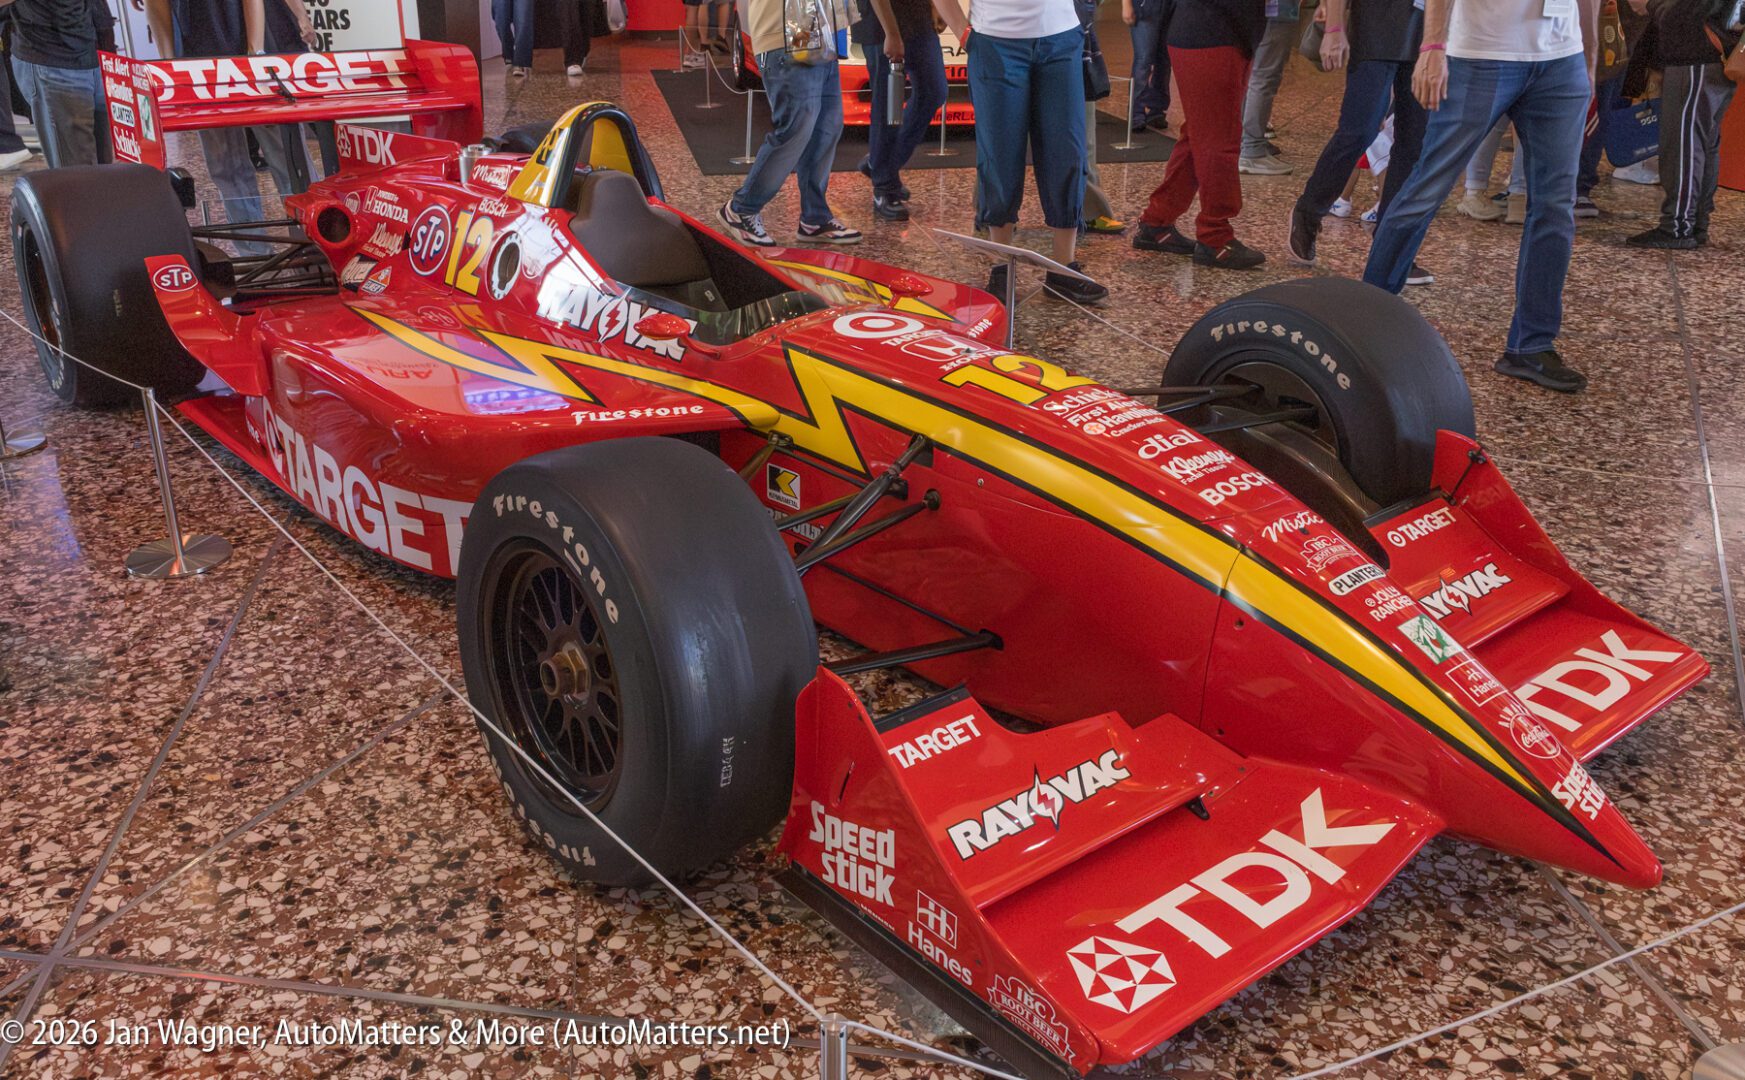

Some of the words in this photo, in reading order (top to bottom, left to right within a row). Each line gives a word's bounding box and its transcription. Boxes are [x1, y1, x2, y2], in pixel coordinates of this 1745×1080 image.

[172, 52, 406, 99] TARGET
[347, 126, 396, 166] TDK
[372, 200, 409, 224] HONDA
[479, 198, 509, 217] BOSCH
[413, 215, 446, 262] STP
[444, 210, 494, 297] 12
[160, 268, 193, 287] STP
[1210, 320, 1350, 390] Firestone
[939, 353, 1101, 407] 12
[571, 404, 704, 426] Firestone
[1043, 388, 1121, 416] Schick
[1067, 406, 1107, 428] First
[1138, 428, 1202, 460] dial
[1160, 450, 1230, 480] Kleenex
[275, 414, 475, 577] TARGET
[1198, 470, 1274, 506] BOSCH
[1261, 510, 1325, 543] Mistic
[1398, 507, 1456, 541] TARGET
[493, 493, 620, 625] Firestone
[1373, 585, 1402, 605] JOLLY
[1511, 629, 1684, 732] TDK
[888, 714, 984, 769] TARGET
[946, 748, 1133, 862] RAYOVAC
[1114, 787, 1397, 959] TDK
[908, 920, 973, 986] Hanes
[1000, 994, 1031, 1021] ROOT
[1032, 1014, 1062, 1046] BEER
[1016, 986, 1047, 1019] IBC
